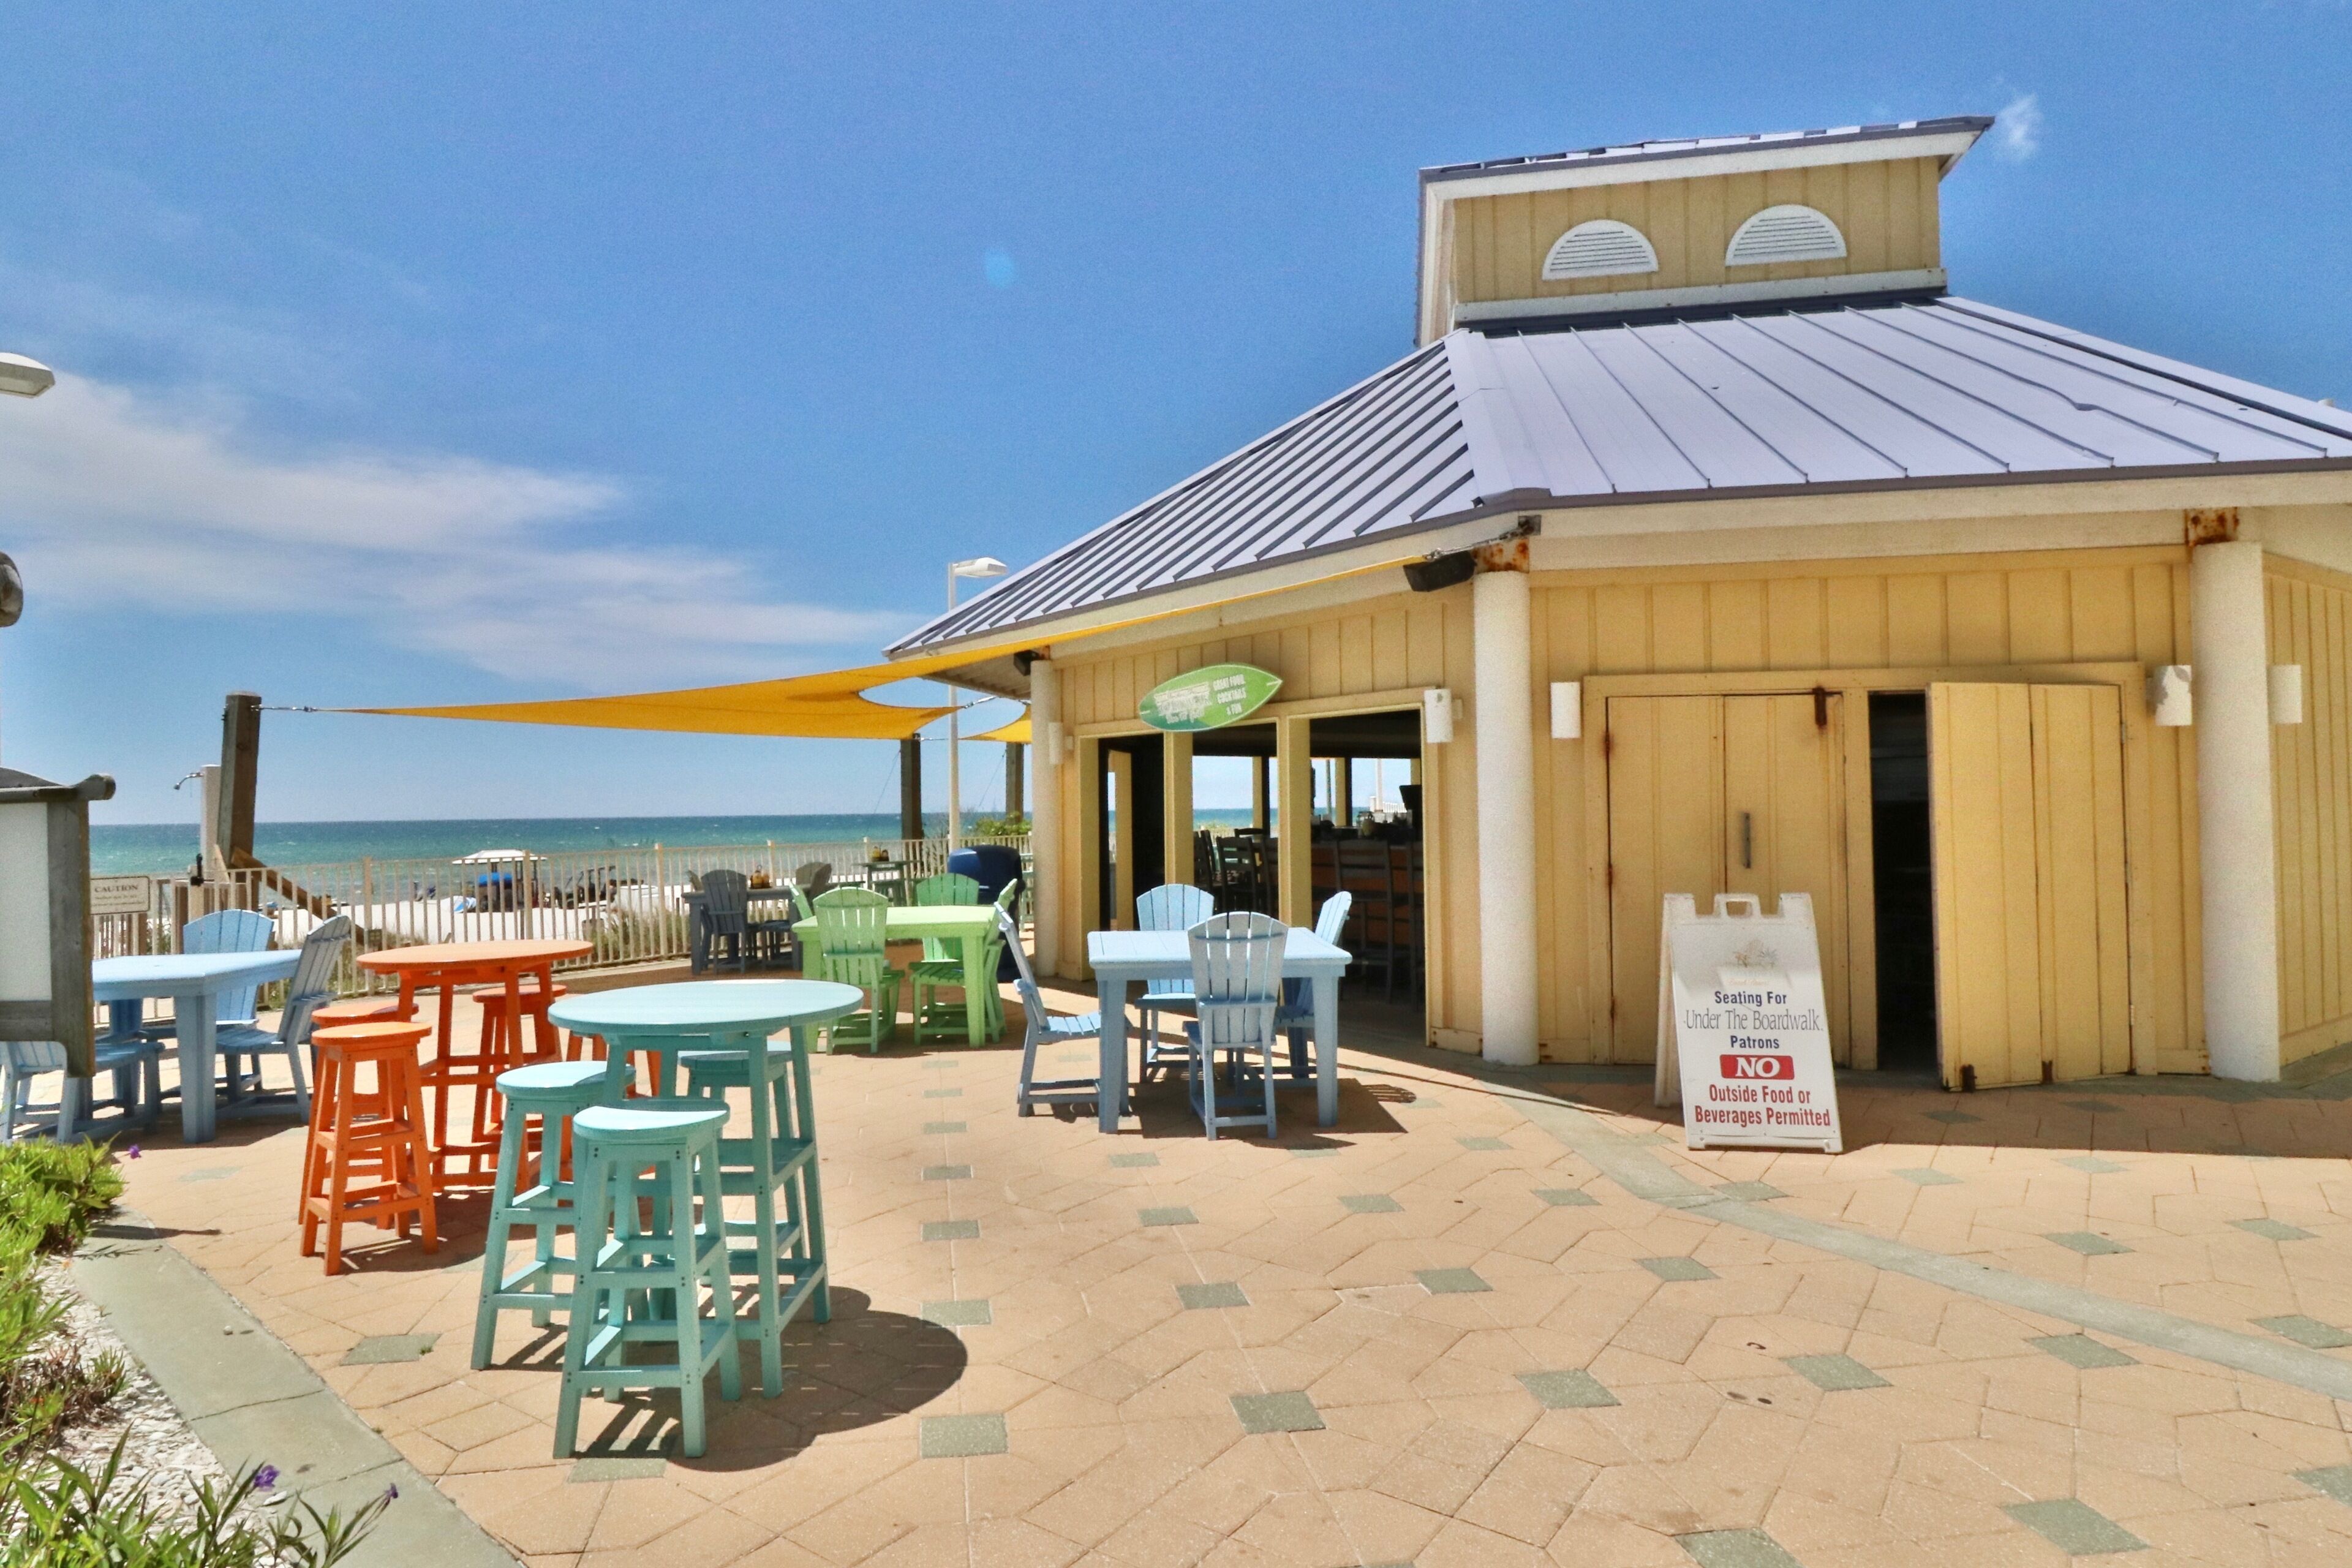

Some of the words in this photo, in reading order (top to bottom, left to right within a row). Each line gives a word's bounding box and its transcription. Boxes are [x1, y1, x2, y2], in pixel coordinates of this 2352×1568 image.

[94, 884, 138, 893] CAUTION
[1714, 991, 1762, 1006] Seating
[1767, 992, 1787, 1005] For
[1686, 1008, 1721, 1029] Under
[1725, 1008, 1747, 1029] The
[1730, 1035, 1779, 1049] Patrons
[1735, 1057, 1780, 1077] NO
[1709, 1084, 1757, 1102] Outside
[1763, 1087, 1793, 1103] Food
[1798, 1090, 1811, 1104] or
[1695, 1105, 1762, 1128] Beverages
[1766, 1107, 1830, 1126] Permitted
